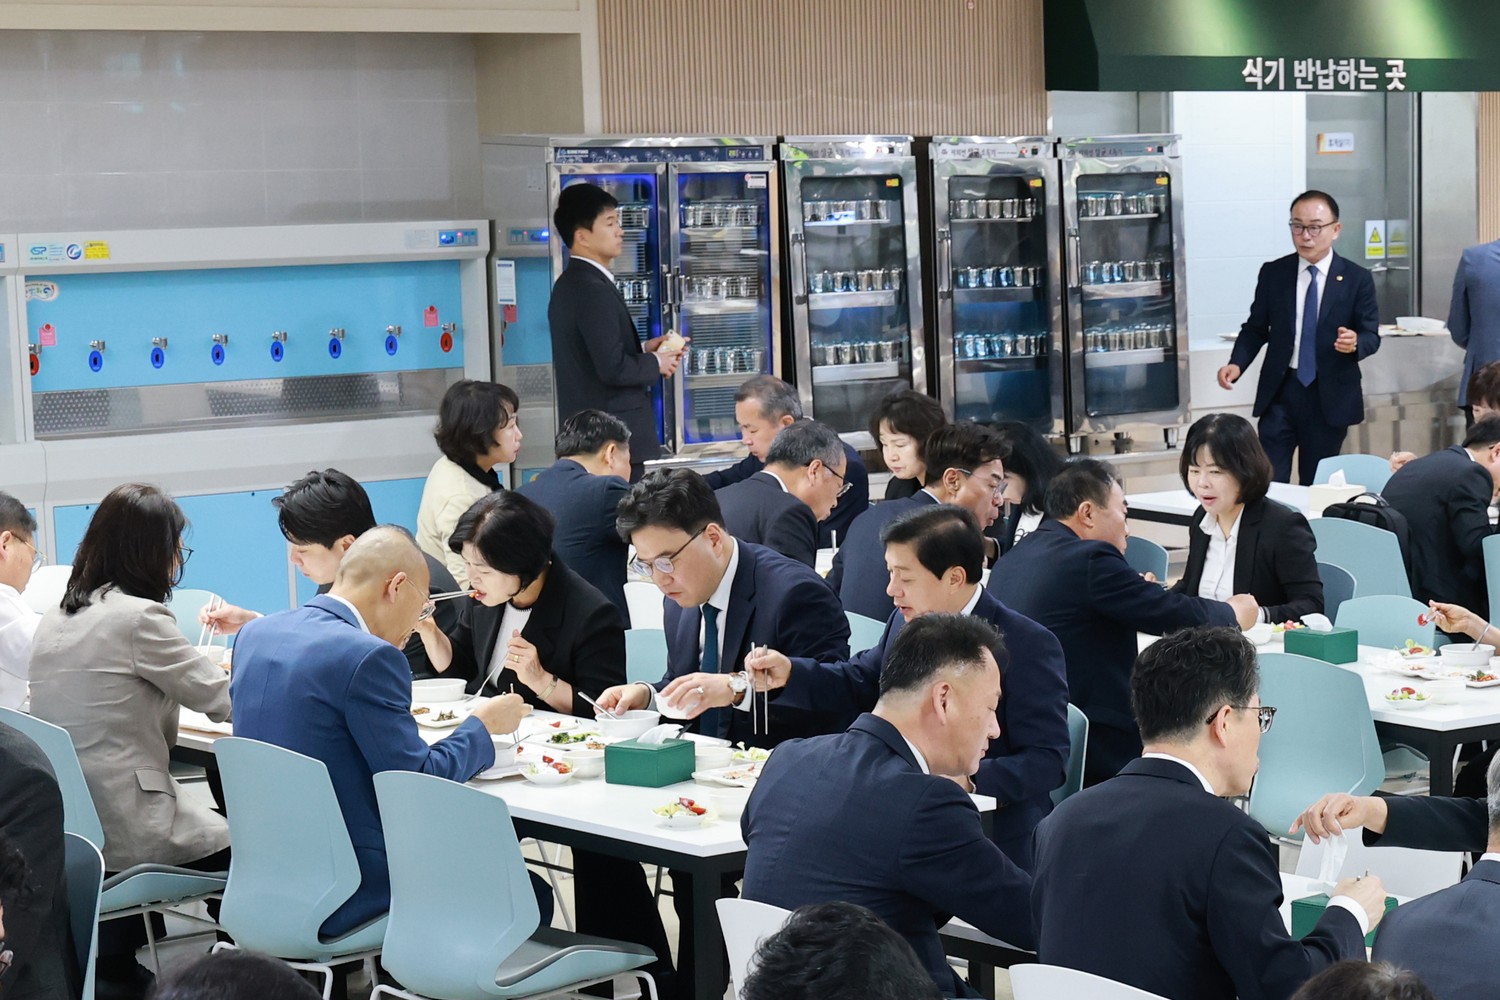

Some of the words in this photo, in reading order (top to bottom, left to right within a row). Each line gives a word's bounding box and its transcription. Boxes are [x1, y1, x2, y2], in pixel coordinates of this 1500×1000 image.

[1242, 57, 1285, 90] 식기
[1293, 58, 1379, 90] 반납하는
[1385, 60, 1407, 91] 곳
